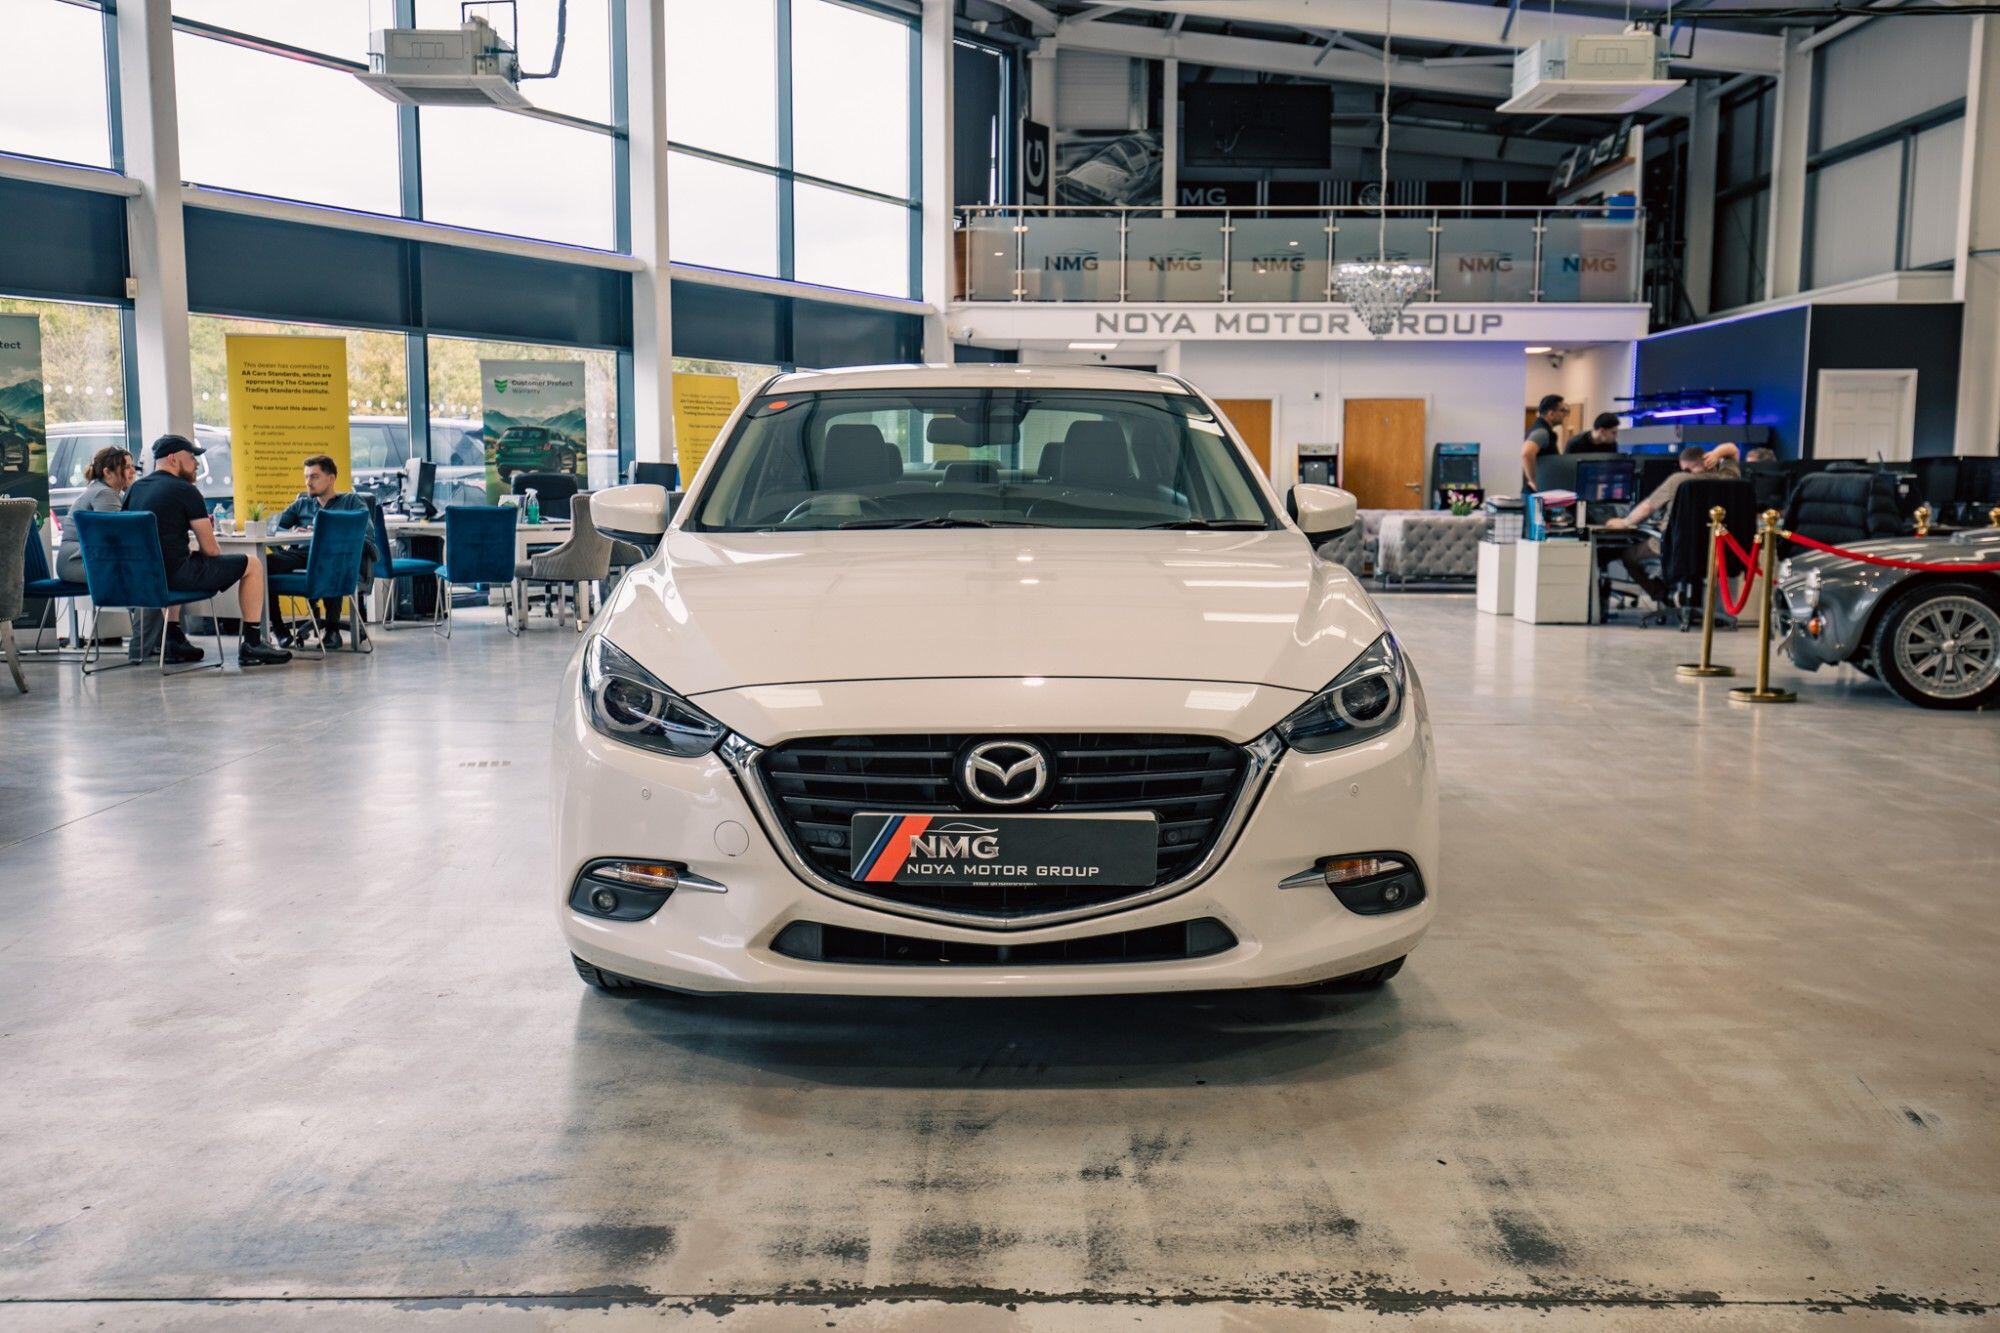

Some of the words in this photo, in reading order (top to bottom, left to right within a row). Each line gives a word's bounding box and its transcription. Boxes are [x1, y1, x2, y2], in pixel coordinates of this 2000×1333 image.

[1045, 256, 1099, 271] NMG
[1149, 256, 1202, 271] NMG
[1252, 256, 1305, 271] NMG
[1563, 256, 1617, 272] NMG
[1096, 313, 1196, 333] NOYA
[1215, 313, 1349, 334] MOTOR
[268, 370, 301, 378] Standards,
[246, 387, 268, 395] Trading
[909, 835, 999, 859] NMG
[907, 864, 955, 875] NOYA
[964, 865, 1027, 876] MOTOR
[1036, 866, 1099, 877] GROUP
